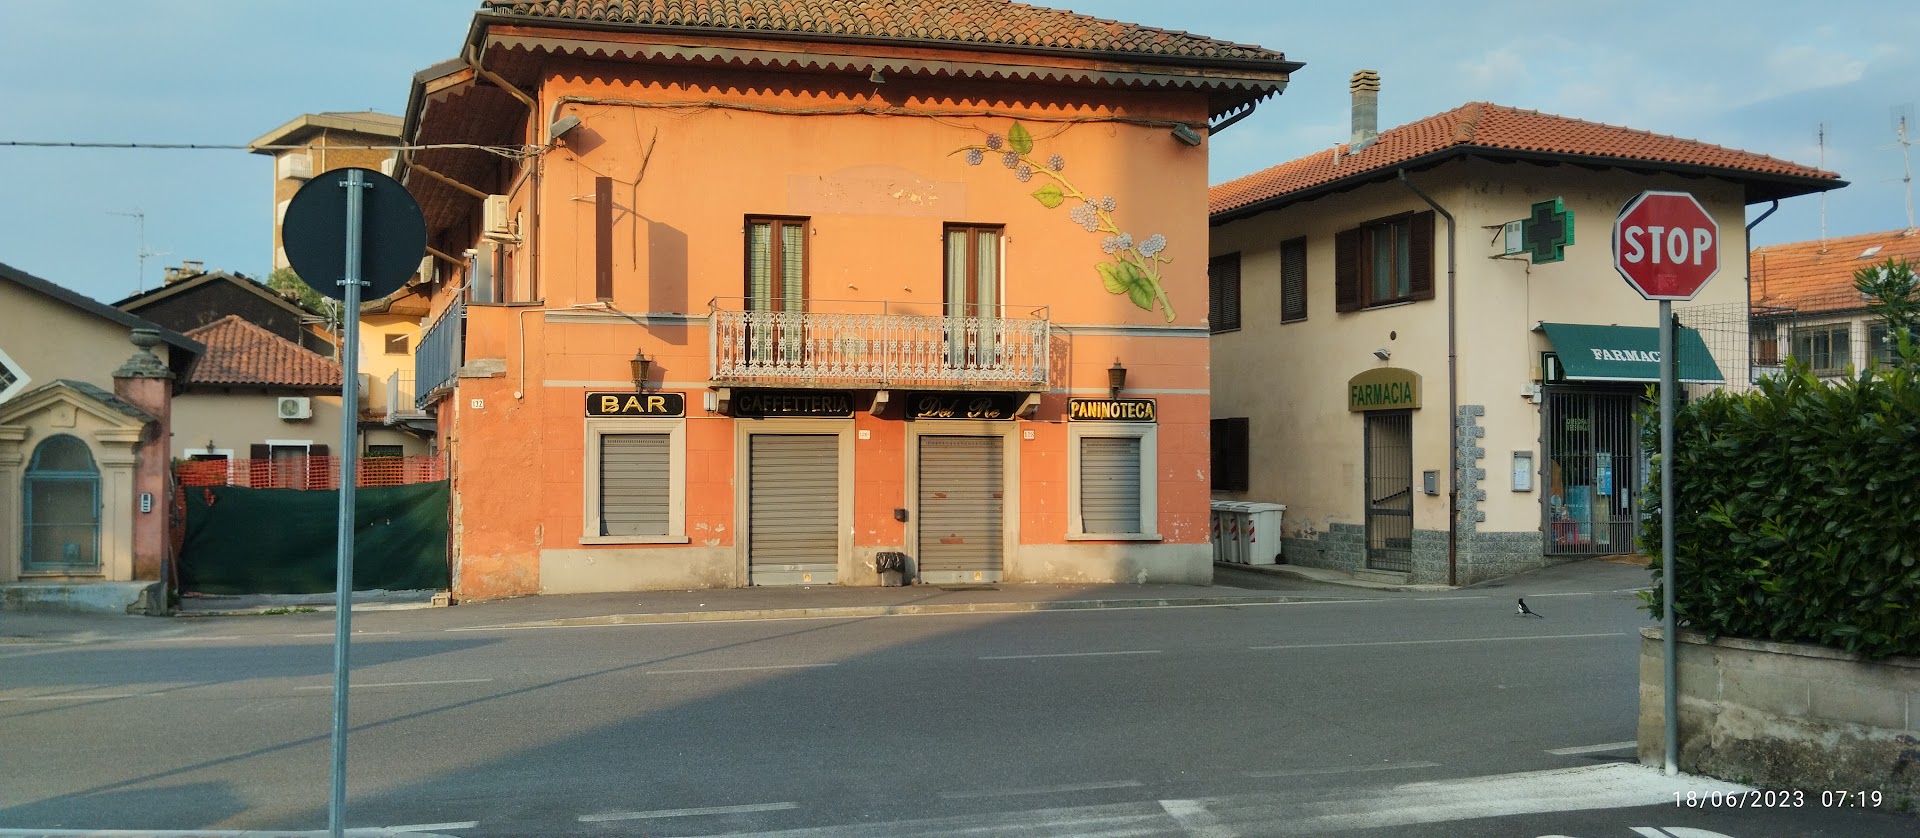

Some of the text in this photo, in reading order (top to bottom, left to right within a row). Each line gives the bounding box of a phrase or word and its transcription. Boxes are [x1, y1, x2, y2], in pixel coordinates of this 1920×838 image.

[1624, 225, 1713, 265] STOP
[1590, 348, 1661, 363] FARMAC
[1351, 381, 1412, 406] FARMACIA
[472, 400, 483, 408] 132
[601, 395, 668, 413] BAR
[739, 395, 849, 413] CAFFETTERIA
[917, 396, 1001, 418] Del Re
